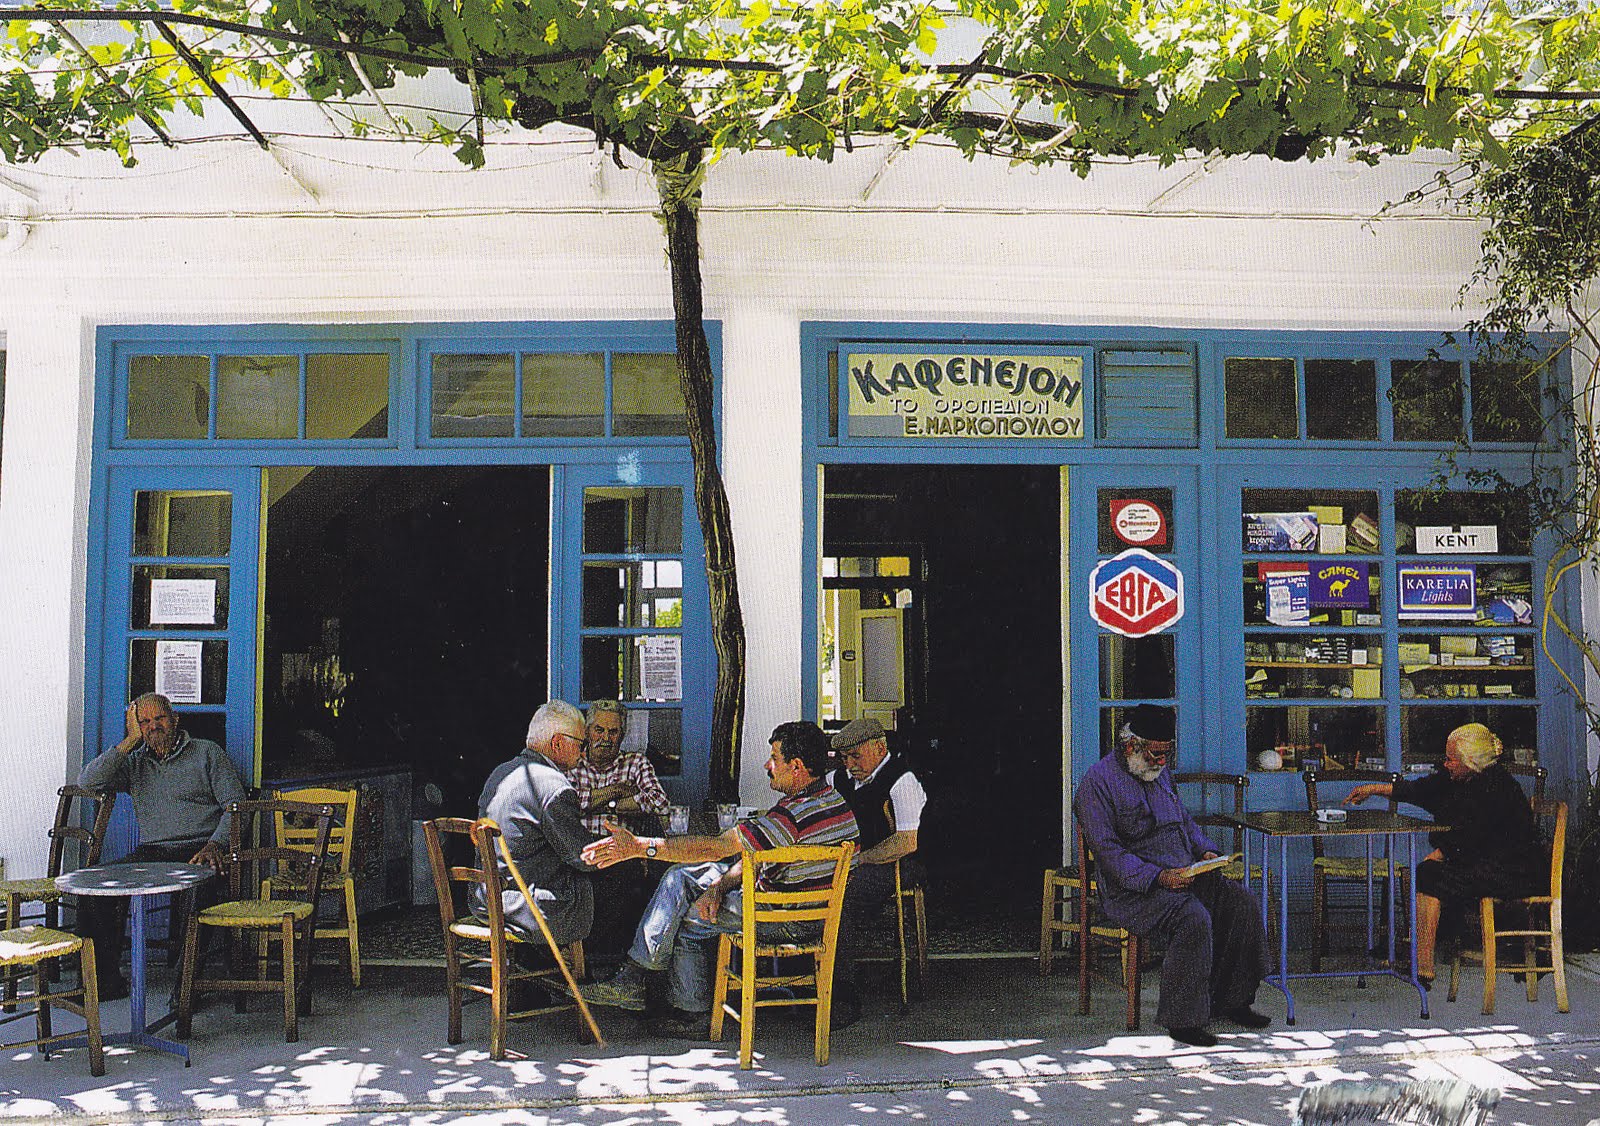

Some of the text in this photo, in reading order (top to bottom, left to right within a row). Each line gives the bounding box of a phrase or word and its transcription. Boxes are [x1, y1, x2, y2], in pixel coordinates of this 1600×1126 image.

[890, 399, 1049, 415] ΤΟ ΟΡΟΠΕΔΙΟΝ
[1435, 535, 1478, 547] KENT
[1318, 566, 1360, 580] CAMEL
[1406, 578, 1469, 590] KARELIA
[1106, 572, 1166, 618] ΕΒΓΑ
[1421, 590, 1454, 604] Lights
